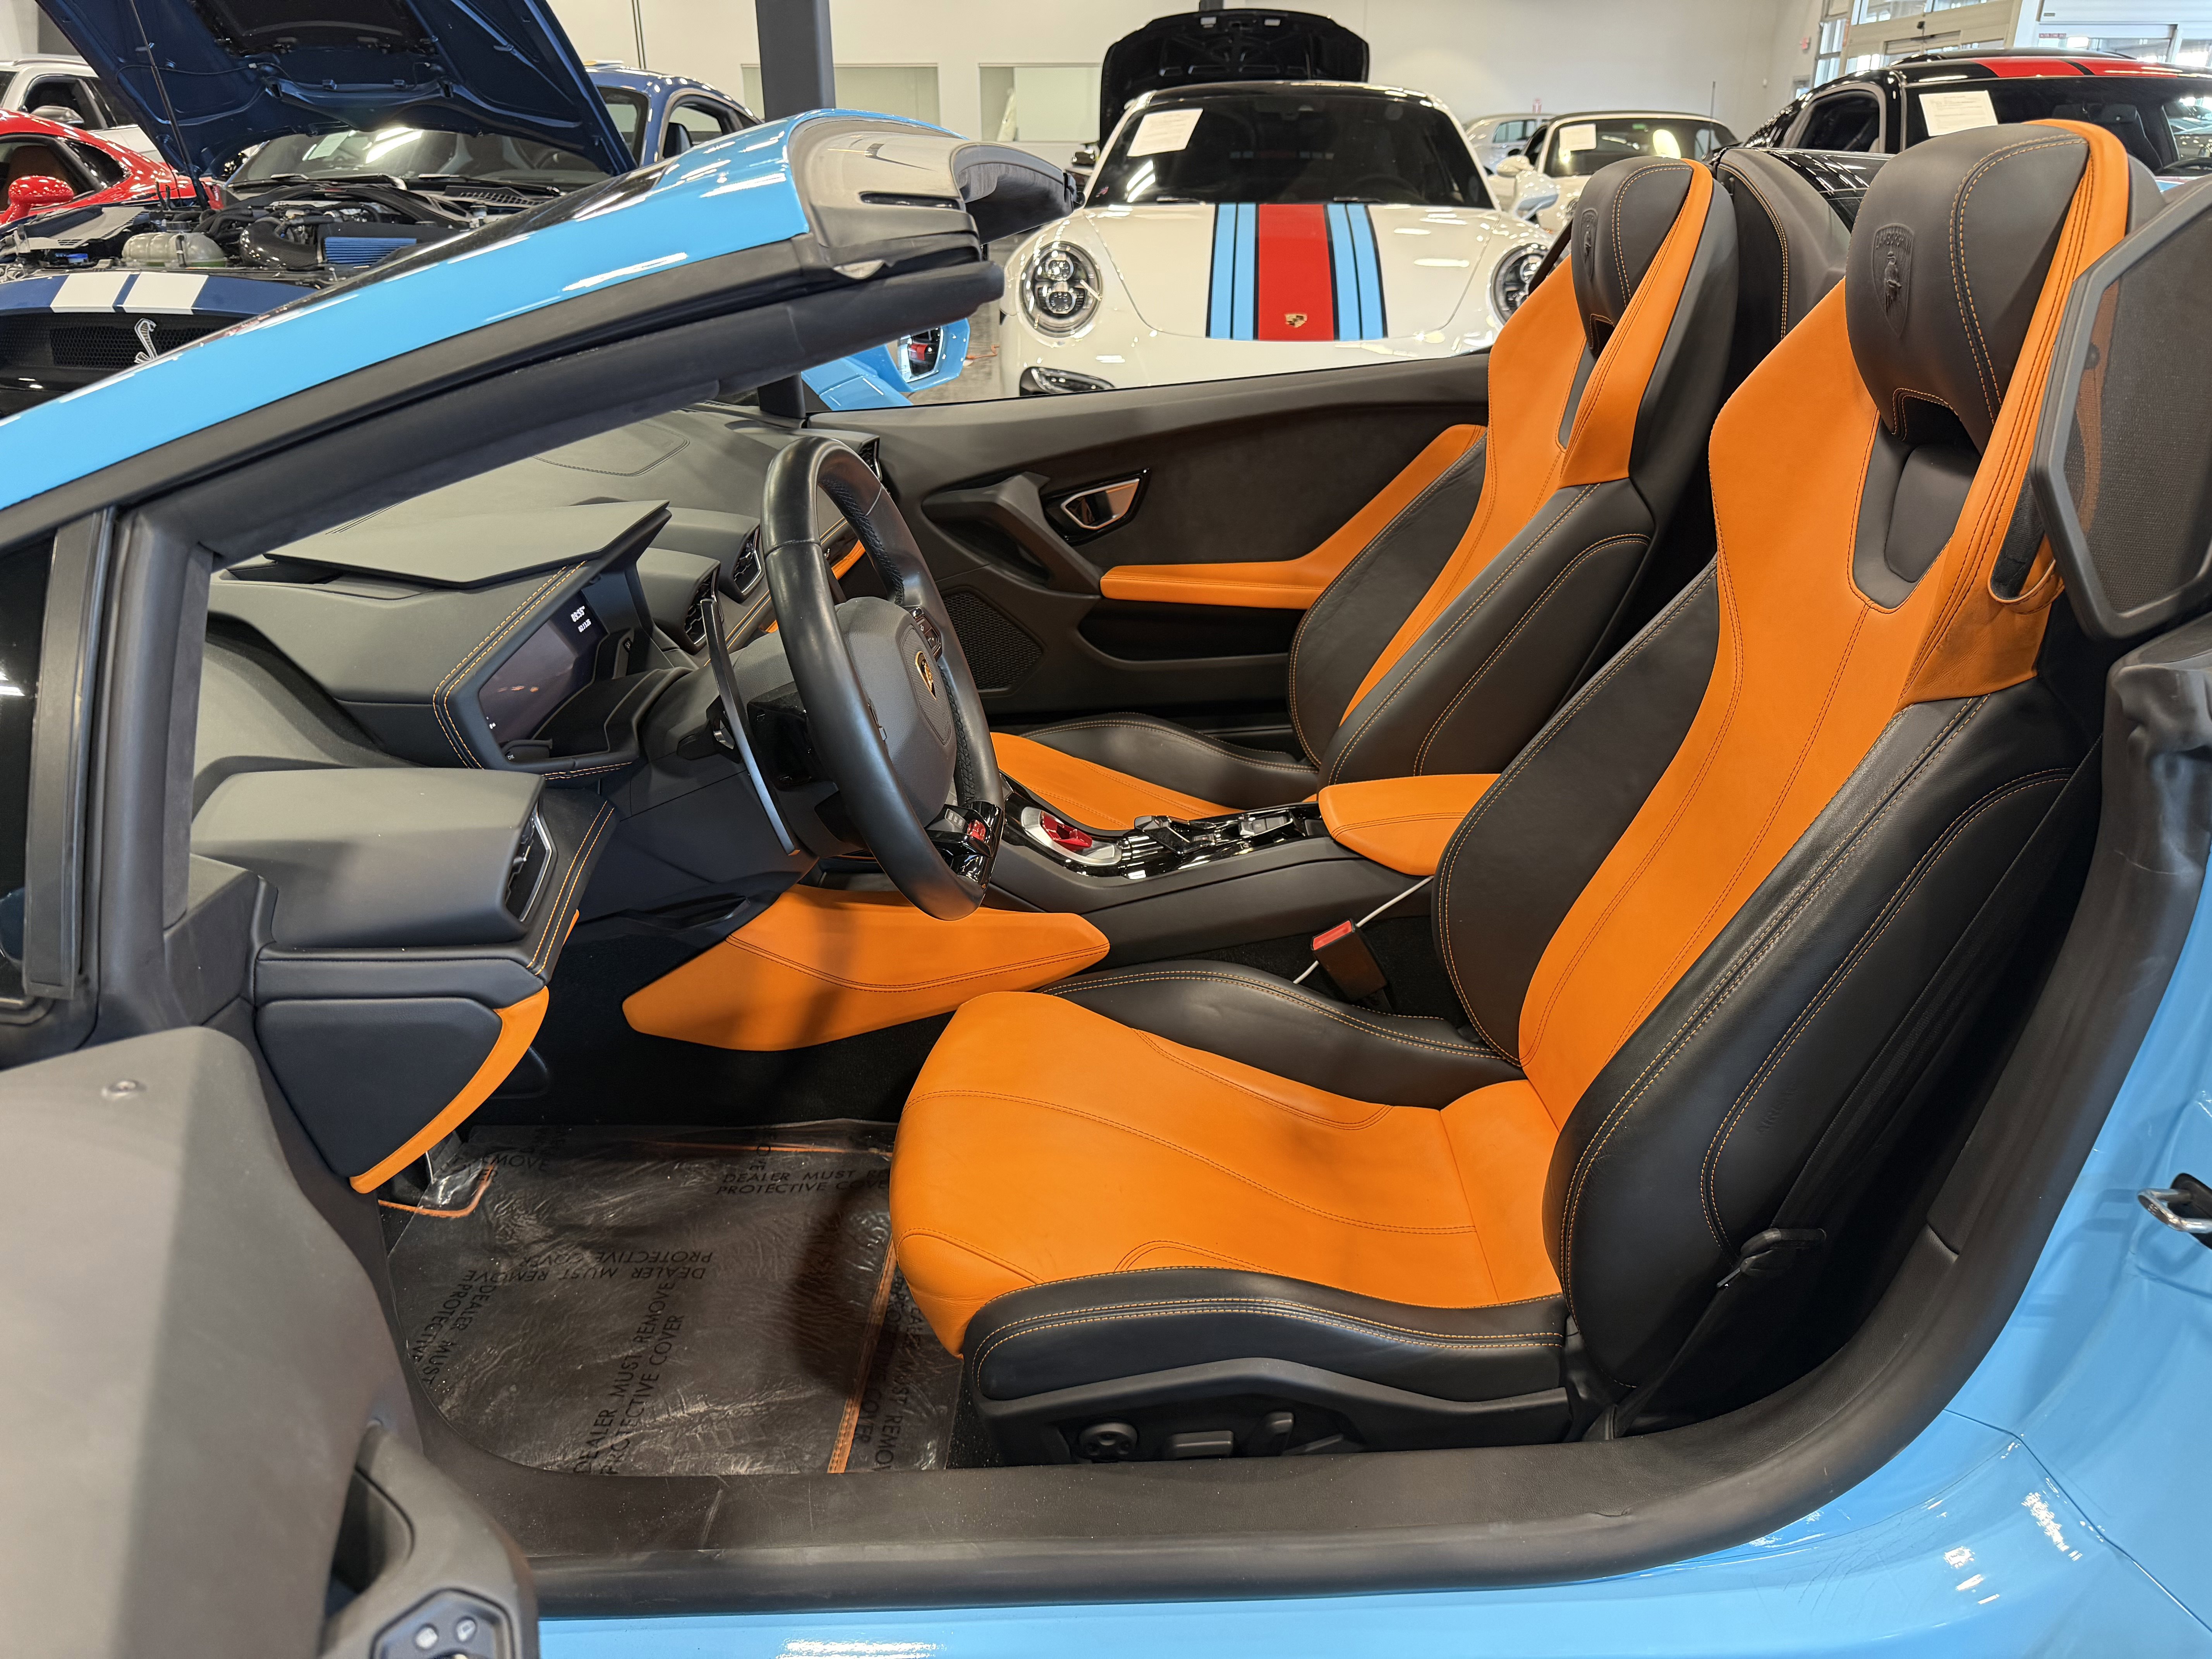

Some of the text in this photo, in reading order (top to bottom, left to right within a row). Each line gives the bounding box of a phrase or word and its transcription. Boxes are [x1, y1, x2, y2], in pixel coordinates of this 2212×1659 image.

[723, 1172, 790, 1183] DEALER
[802, 1170, 856, 1181] MUST
[716, 1182, 827, 1194] PROTECTIVE
[595, 1251, 713, 1264] PROTECTIVE
[462, 1266, 706, 1282] DEALER MUST REMOVE
[421, 1285, 496, 1386] DEALER MUST
[649, 1316, 685, 1365] COVER
[573, 1283, 675, 1474] DEALER MUST REMOVE
